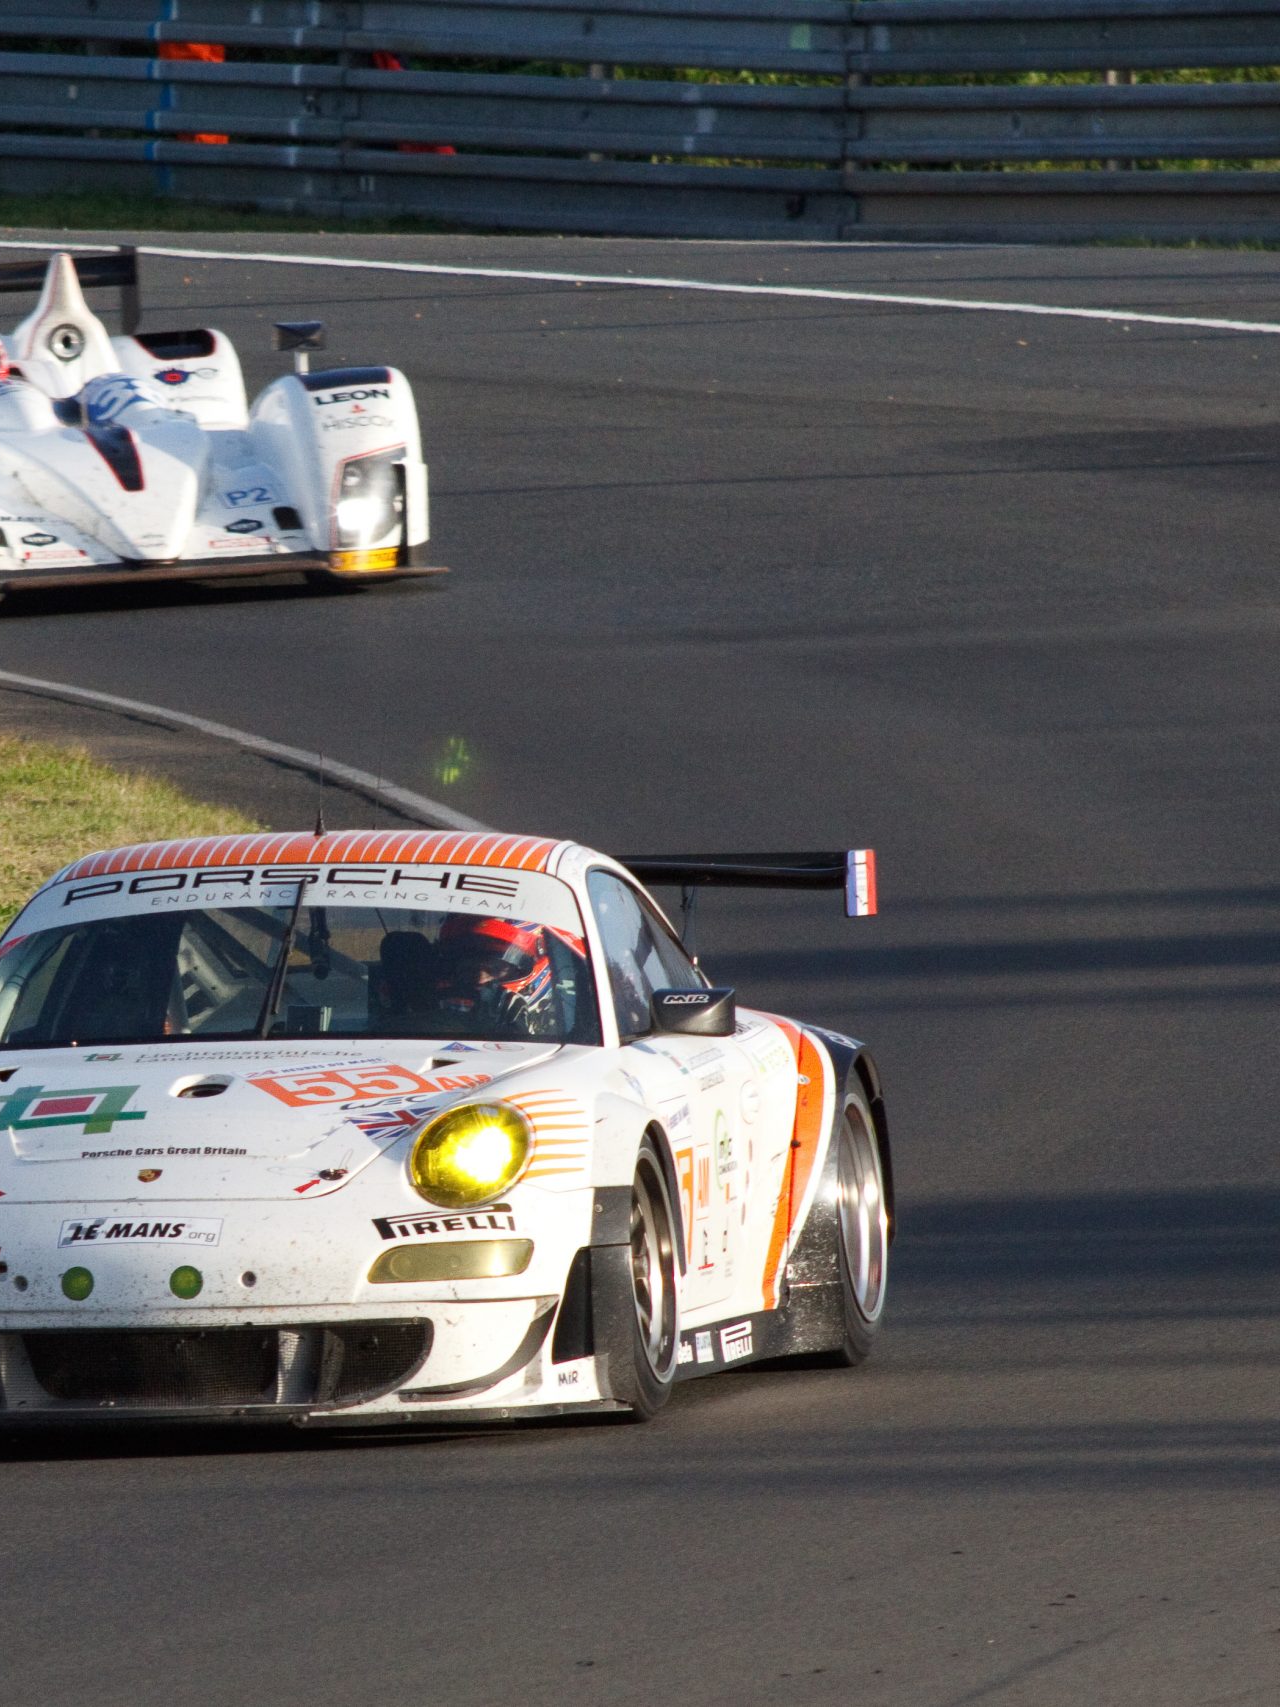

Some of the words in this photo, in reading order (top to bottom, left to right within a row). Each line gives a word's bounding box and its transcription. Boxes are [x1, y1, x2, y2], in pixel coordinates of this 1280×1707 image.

[314, 389, 390, 405] LEON
[226, 487, 272, 506] P2
[63, 868, 519, 906] PORSCHE
[151, 888, 308, 906] ENDURANCE
[326, 889, 429, 902] RACING
[448, 894, 513, 912] TEAM
[276, 1068, 420, 1102] 55
[81, 1148, 132, 1158] Porsche
[136, 1147, 164, 1155] Cars
[167, 1147, 201, 1155] Great
[204, 1146, 247, 1155] Britain
[105, 1222, 186, 1239] MANS
[372, 1203, 516, 1240] PIRELLI
